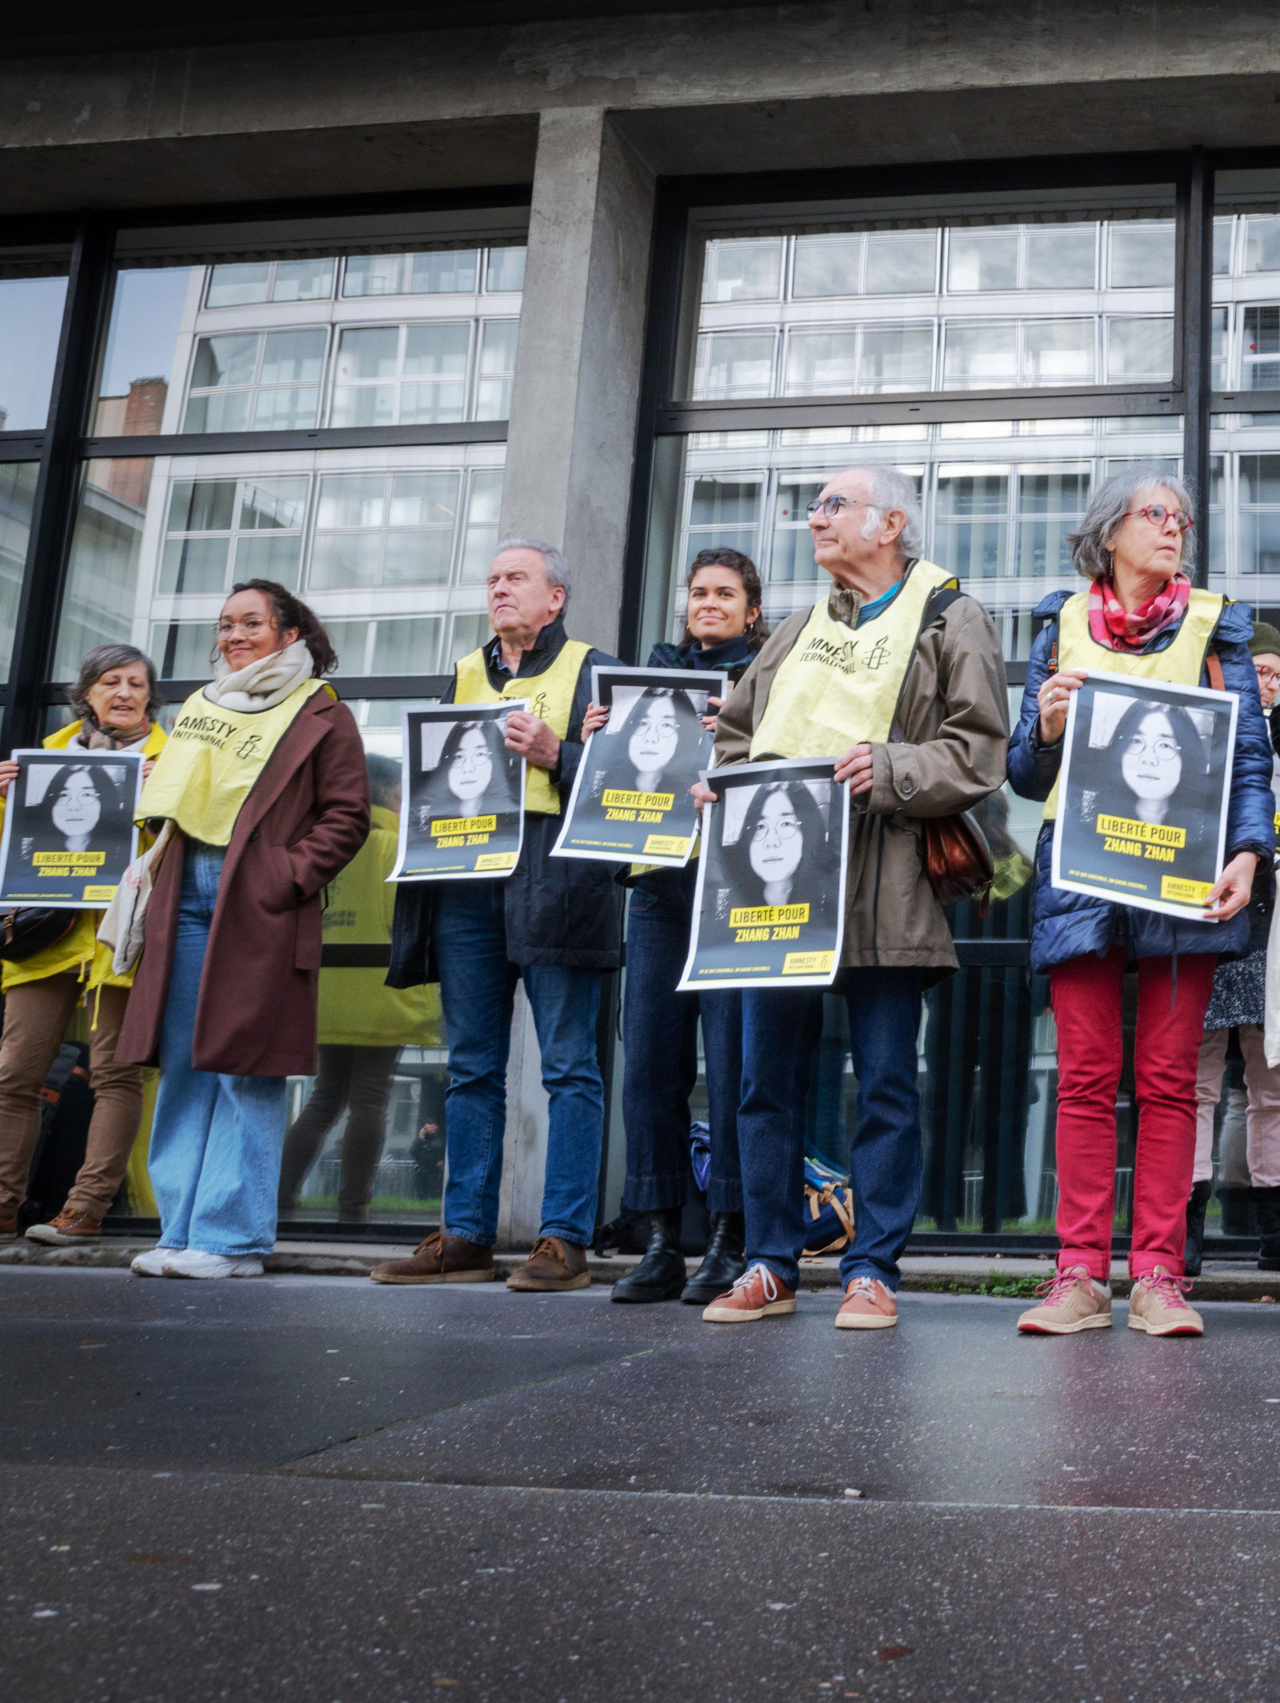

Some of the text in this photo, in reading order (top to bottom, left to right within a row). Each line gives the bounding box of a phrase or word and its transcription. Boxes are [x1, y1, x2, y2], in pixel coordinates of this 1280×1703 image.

[606, 792, 671, 807] LIBERTÉ POUR
[605, 808, 663, 823] ZHANG ZHAN
[434, 817, 493, 833] LIBERTÉ POUR
[1101, 818, 1181, 844] LIBERTÉ POUR
[1103, 837, 1175, 863] ZHANG ZHAN
[1167, 881, 1196, 893] AMNESTY
[733, 907, 806, 924] LIBERTÉ POUR
[734, 925, 800, 943] ZHANG ZHAN
